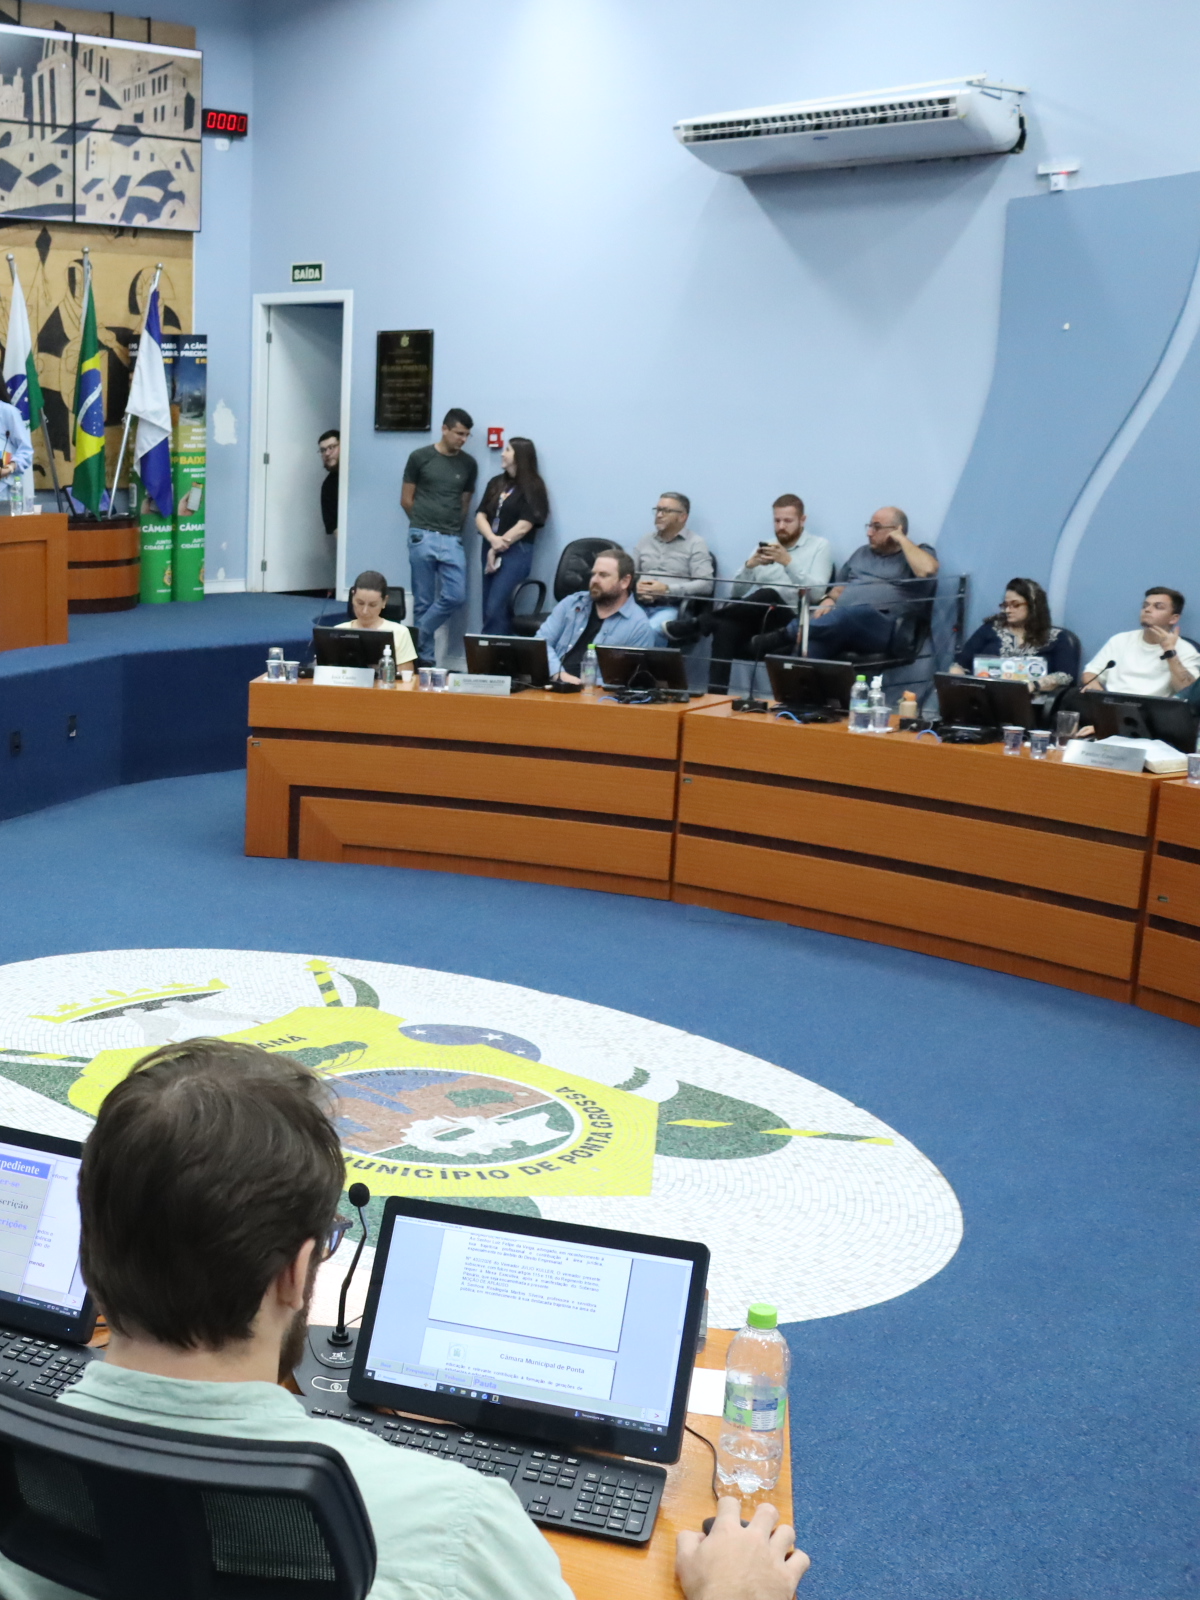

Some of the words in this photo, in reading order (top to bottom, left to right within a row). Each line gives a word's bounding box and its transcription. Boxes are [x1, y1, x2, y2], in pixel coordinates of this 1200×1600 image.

[294, 266, 321, 280] SAÍDA
[554, 1086, 615, 1129] GROSSA
[559, 1129, 614, 1166] PONTA
[517, 1160, 562, 1176] DE
[499, 1353, 524, 1363] Câmara
[524, 1357, 556, 1369] Municipal
[566, 1365, 585, 1374] Ponta
[473, 1379, 497, 1389] Pauta
